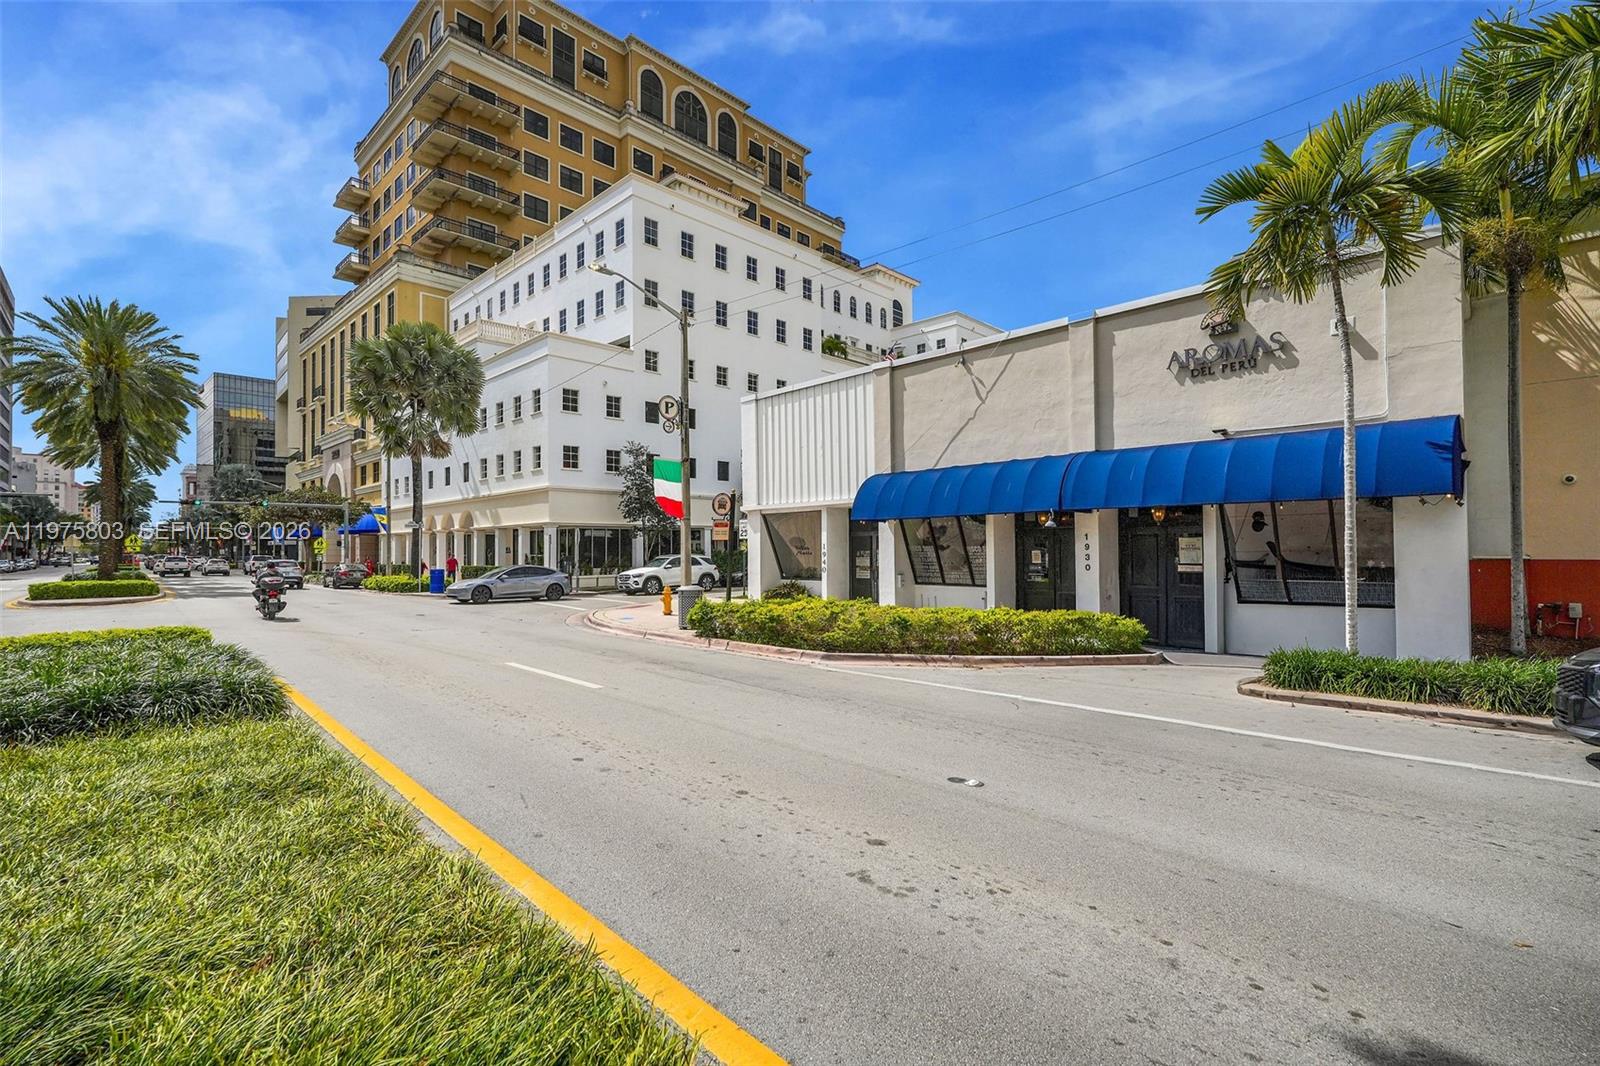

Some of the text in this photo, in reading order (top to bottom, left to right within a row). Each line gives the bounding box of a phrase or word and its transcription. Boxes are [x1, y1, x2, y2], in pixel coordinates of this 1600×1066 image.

[1166, 331, 1285, 370] AROMAS
[1191, 364, 1216, 378] DEL
[663, 400, 675, 415] P
